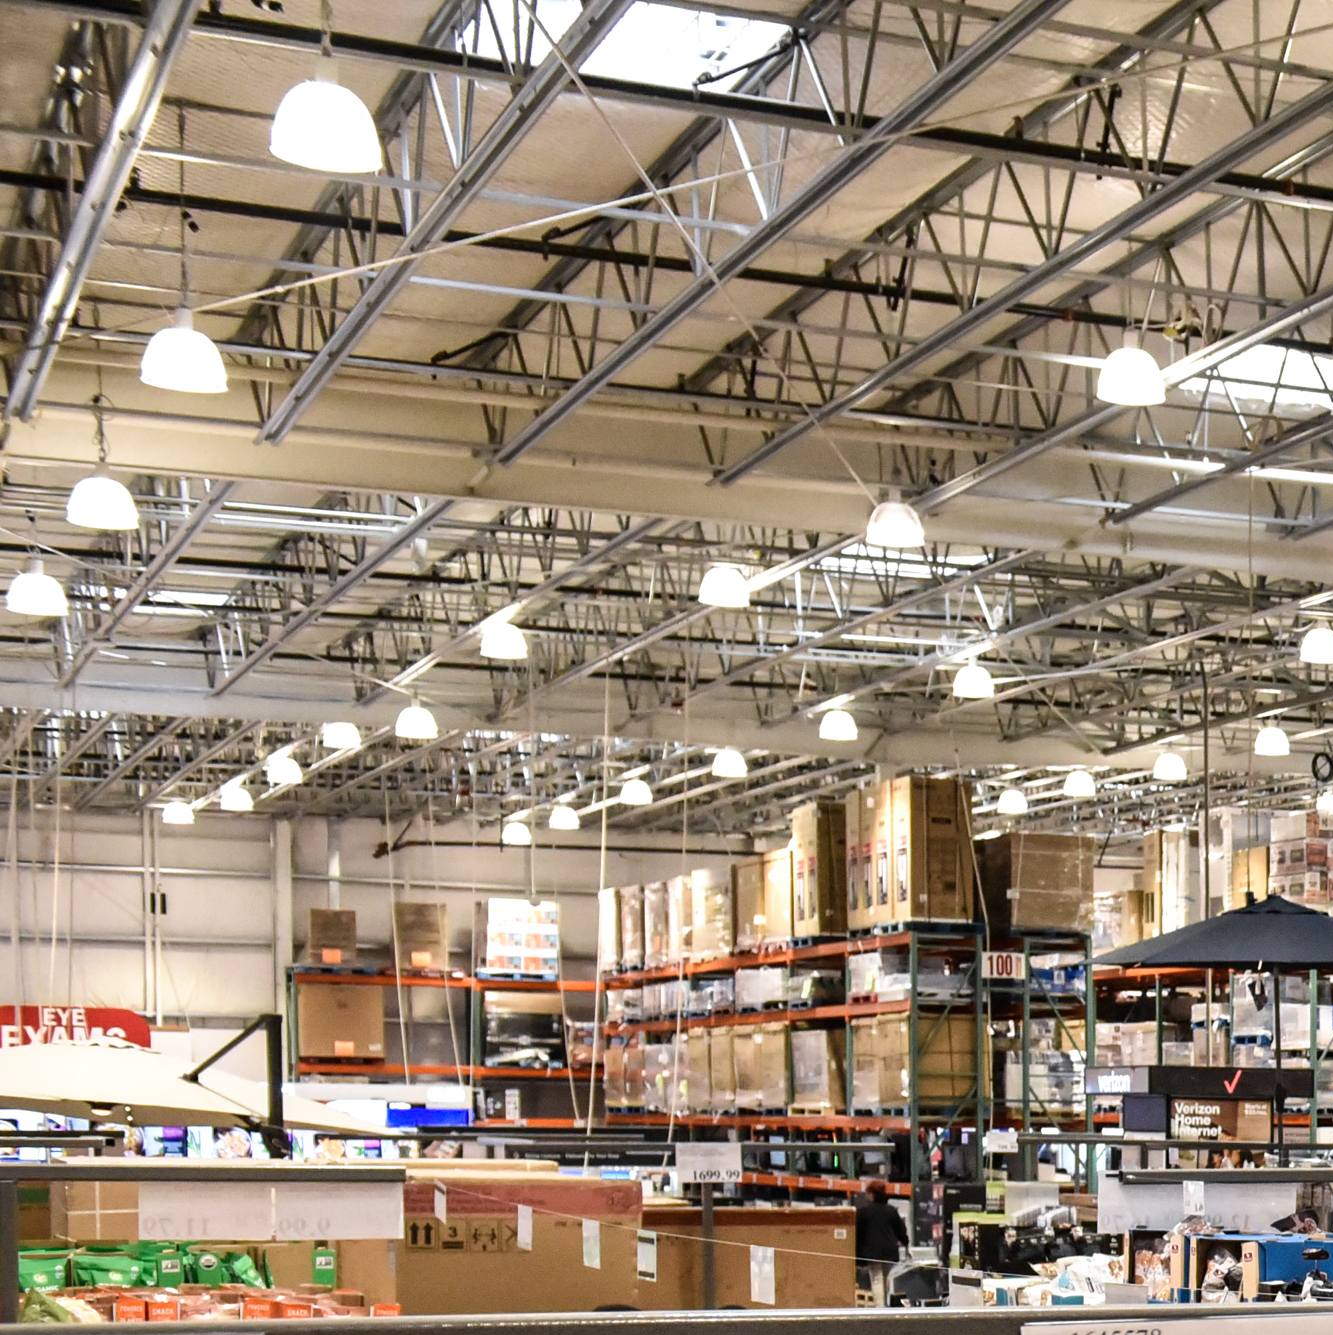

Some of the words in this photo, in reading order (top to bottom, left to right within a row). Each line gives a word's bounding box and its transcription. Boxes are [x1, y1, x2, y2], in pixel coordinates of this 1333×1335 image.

[986, 955, 1014, 976] 100
[43, 1008, 85, 1026] EYE
[1098, 1071, 1131, 1092] verizon
[1175, 1103, 1220, 1114] Verizon
[1175, 1115, 1211, 1124] Home
[1175, 1125, 1222, 1137] Internet
[692, 1170, 740, 1181] 1699.99
